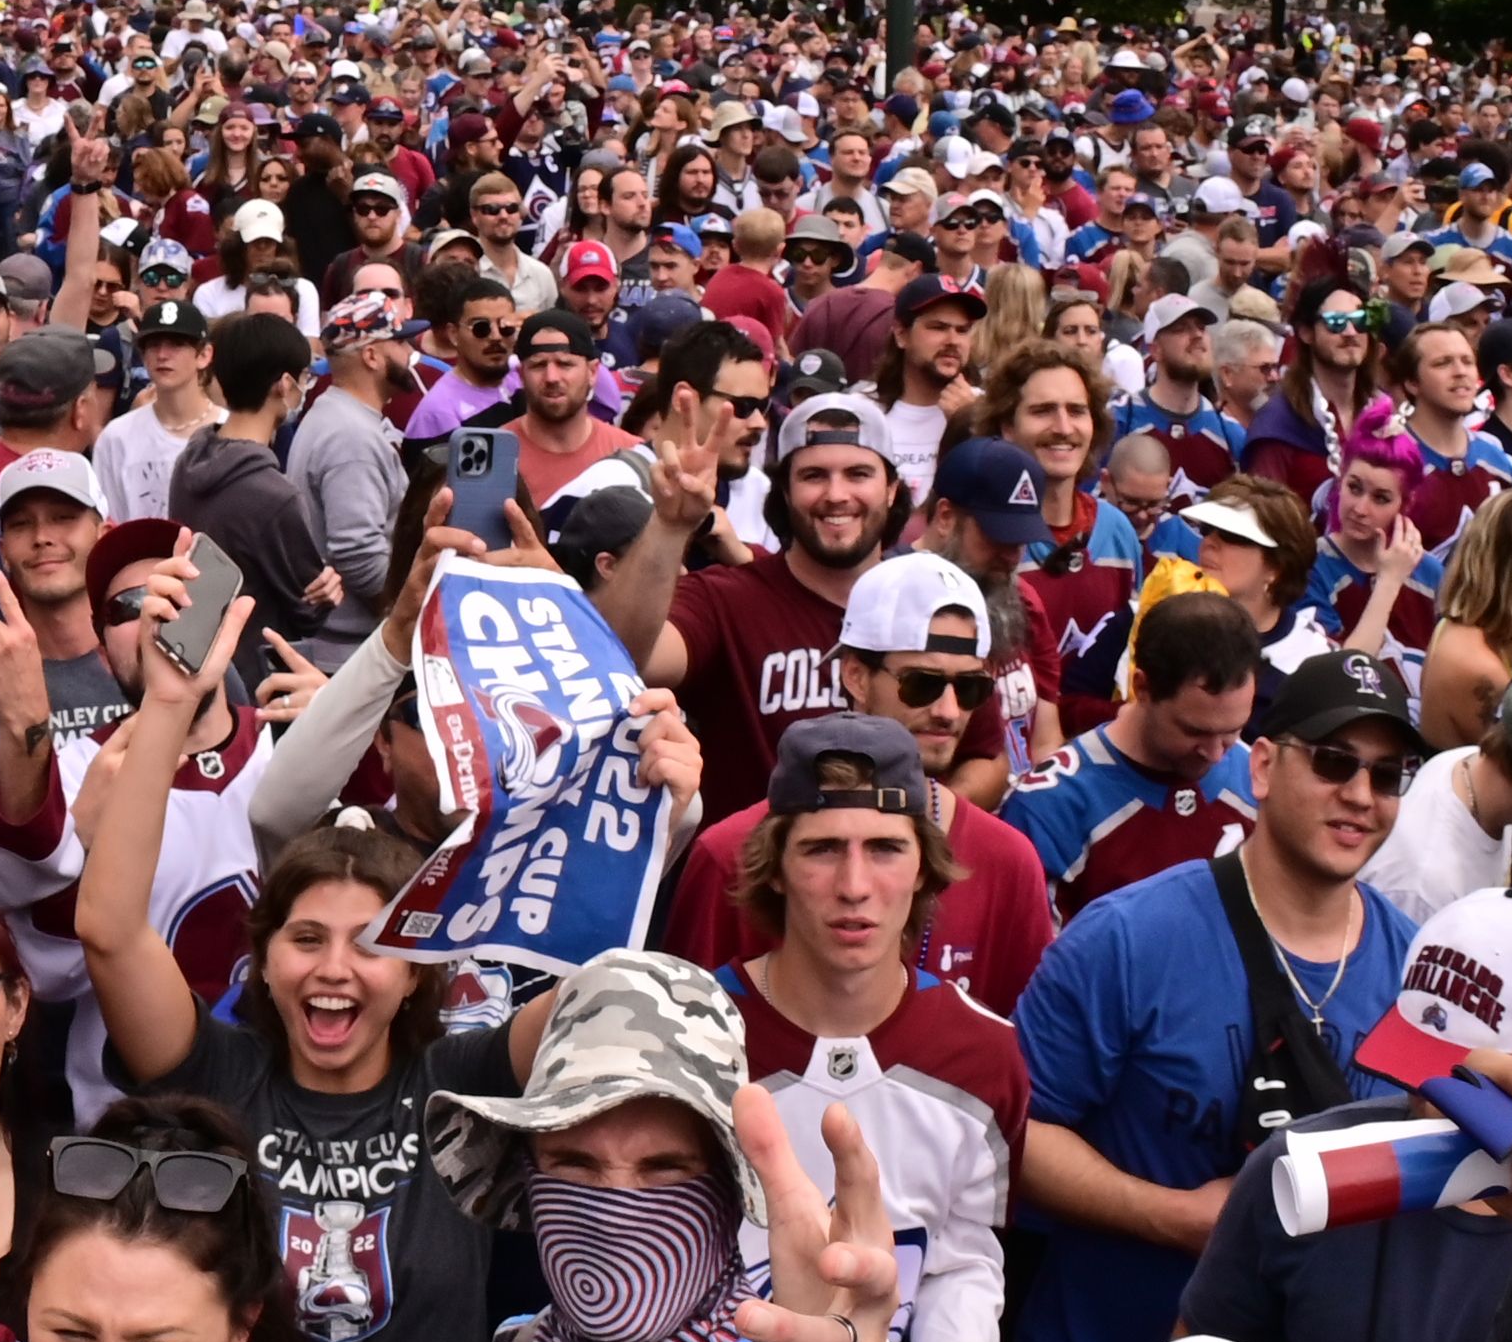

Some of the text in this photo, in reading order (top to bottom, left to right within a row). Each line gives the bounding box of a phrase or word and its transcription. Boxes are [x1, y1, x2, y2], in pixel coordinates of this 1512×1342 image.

[516, 596, 620, 935] STANLEY CUP
[584, 668, 648, 853] 2022
[289, 1233, 377, 1255] 20 22
